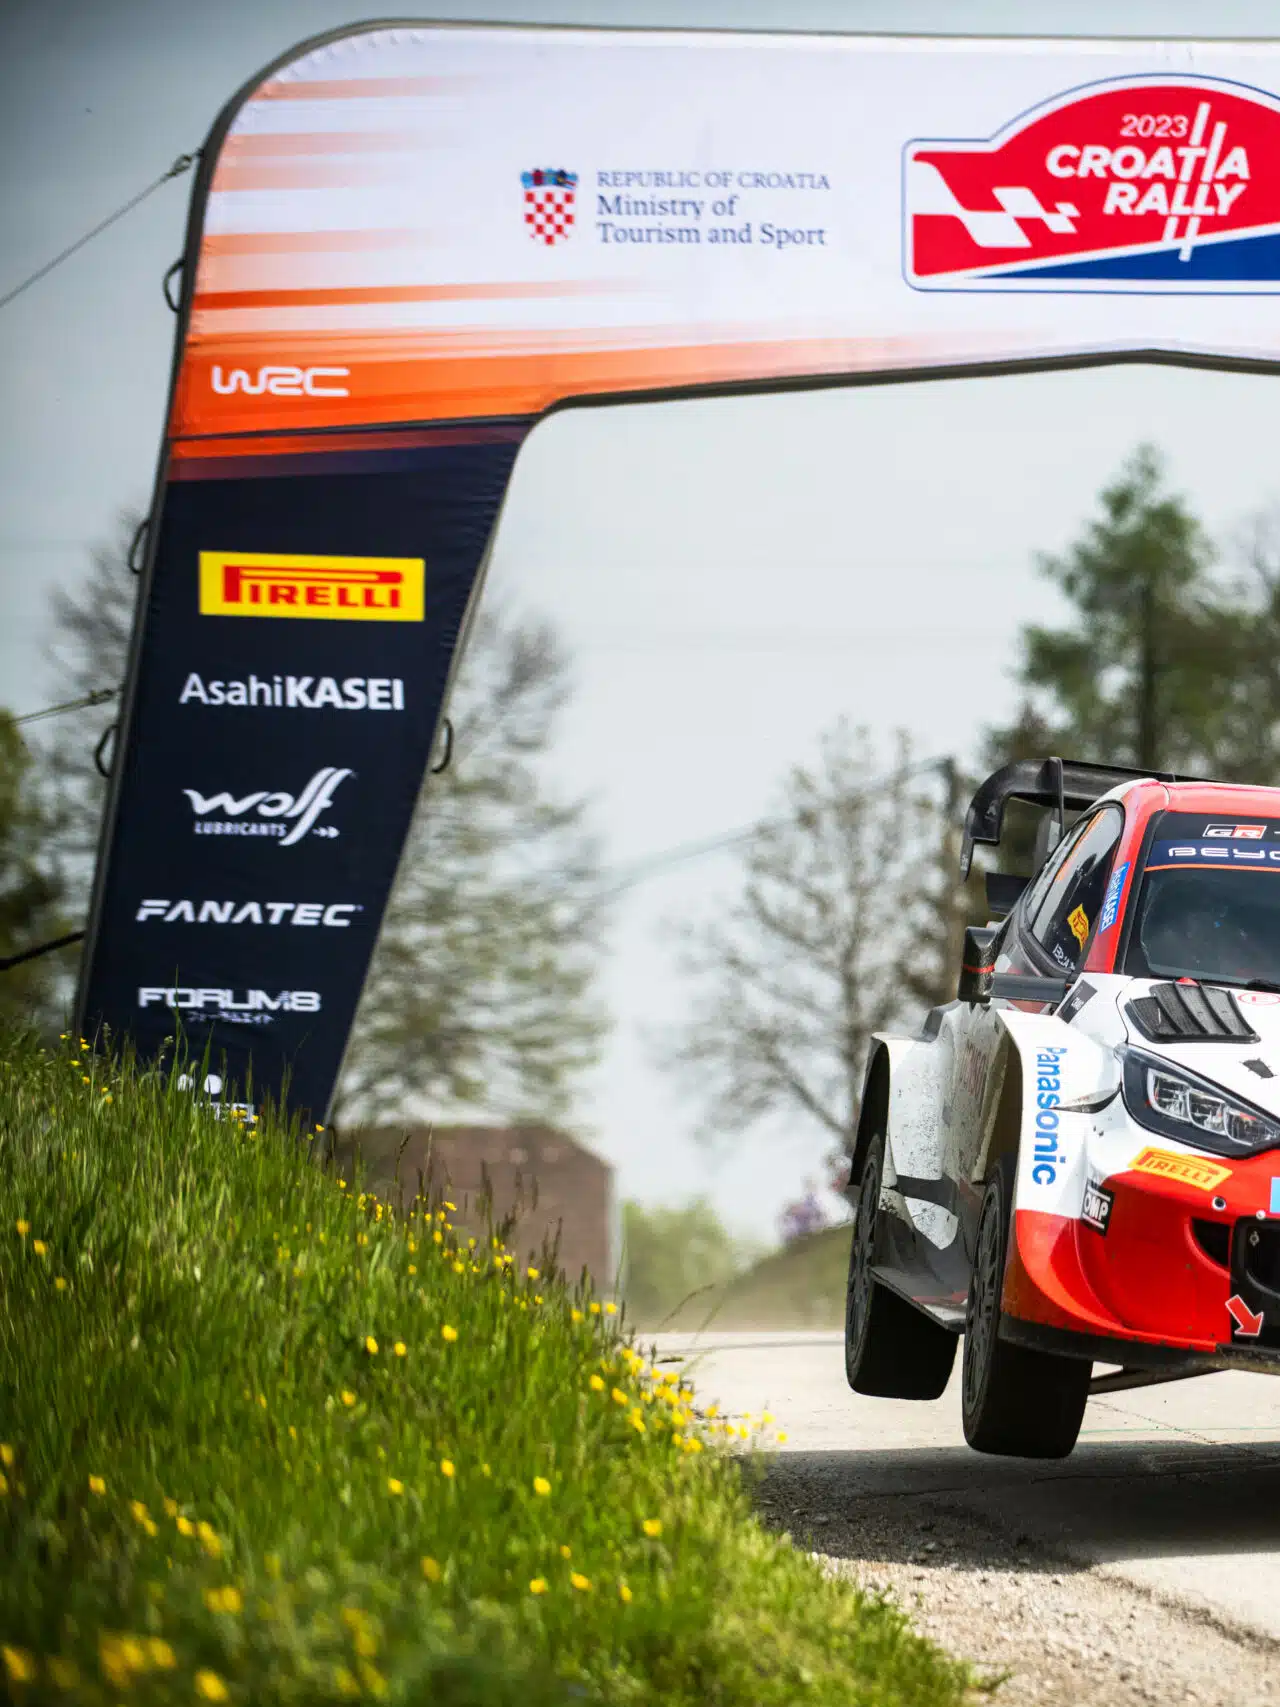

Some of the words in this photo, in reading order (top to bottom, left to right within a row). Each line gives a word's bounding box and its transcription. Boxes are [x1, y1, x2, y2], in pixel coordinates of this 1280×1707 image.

[1120, 115, 1188, 137] 2023
[1045, 144, 1250, 183] CROATIA
[596, 171, 700, 188] REPUBLIC
[704, 171, 732, 188] OF
[737, 172, 831, 189] CROATIA
[597, 194, 704, 220] Ministry
[712, 194, 739, 216] of
[1102, 183, 1245, 218] RALLY
[596, 221, 700, 244] Tourism
[707, 222, 752, 245] and
[759, 223, 826, 249] Sport
[211, 366, 350, 397] WRC
[222, 564, 404, 608] PIRELLI
[179, 673, 404, 710] AsahiKASEI
[195, 822, 286, 837] LUBRICANTS
[1205, 826, 1263, 839] GR
[136, 899, 356, 927] FANATEC
[138, 987, 321, 1012] FORUM8
[1032, 1047, 1067, 1185] Panasonic
[1137, 1150, 1221, 1184] PIRELLI
[1084, 1192, 1109, 1221] OMP
